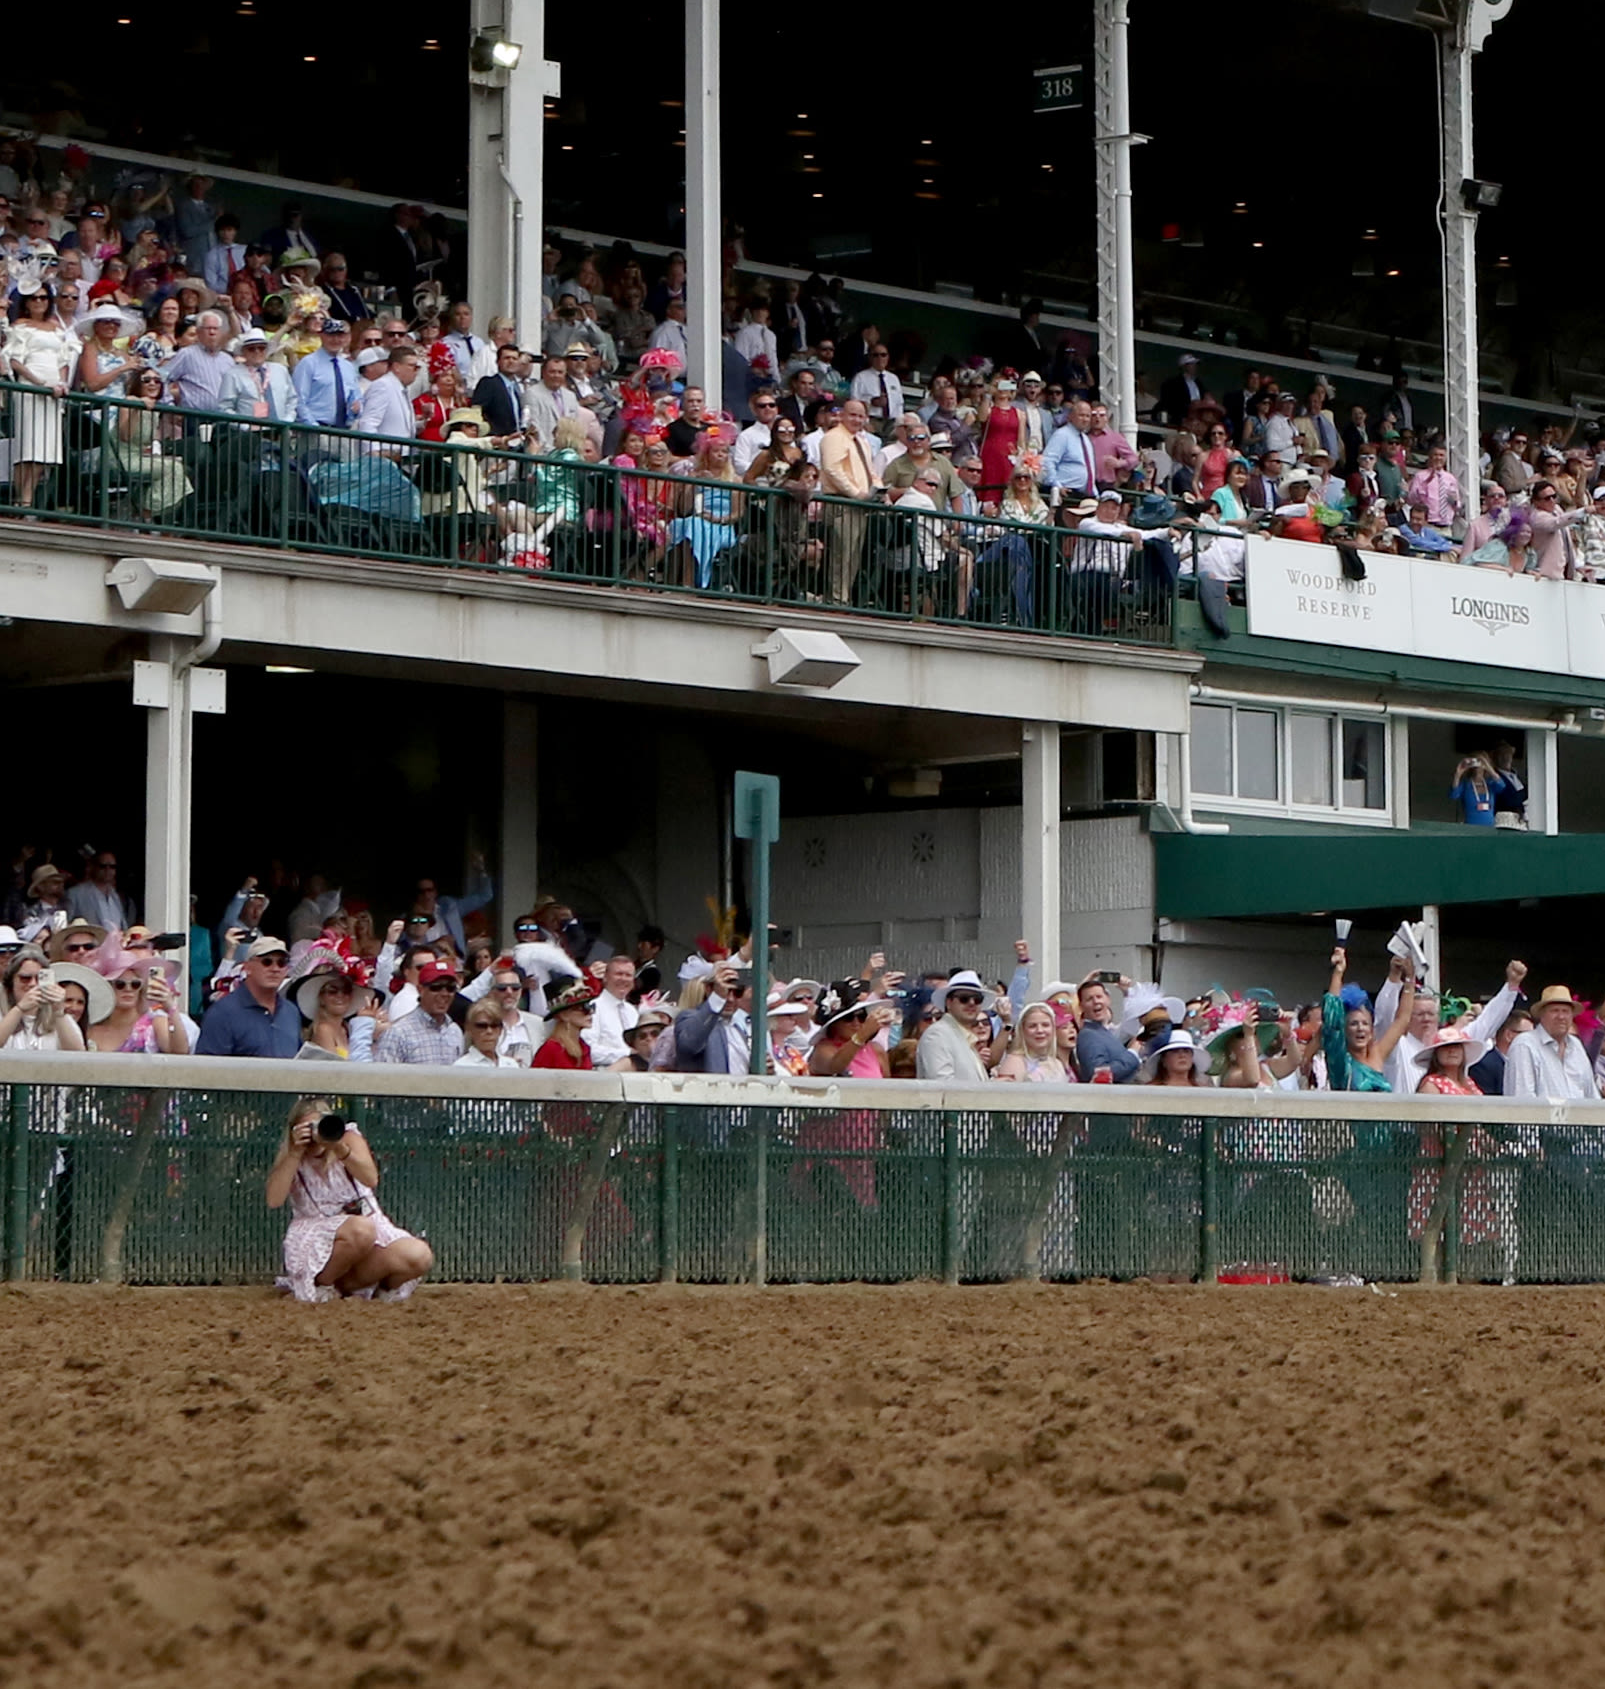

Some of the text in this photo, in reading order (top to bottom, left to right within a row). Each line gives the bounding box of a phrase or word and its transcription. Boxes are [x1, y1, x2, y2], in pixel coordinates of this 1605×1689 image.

[1042, 78, 1073, 98] 318
[1286, 568, 1377, 596] WOODFORD
[1297, 595, 1373, 621] RESERVE
[1451, 596, 1531, 626] LONGINES
